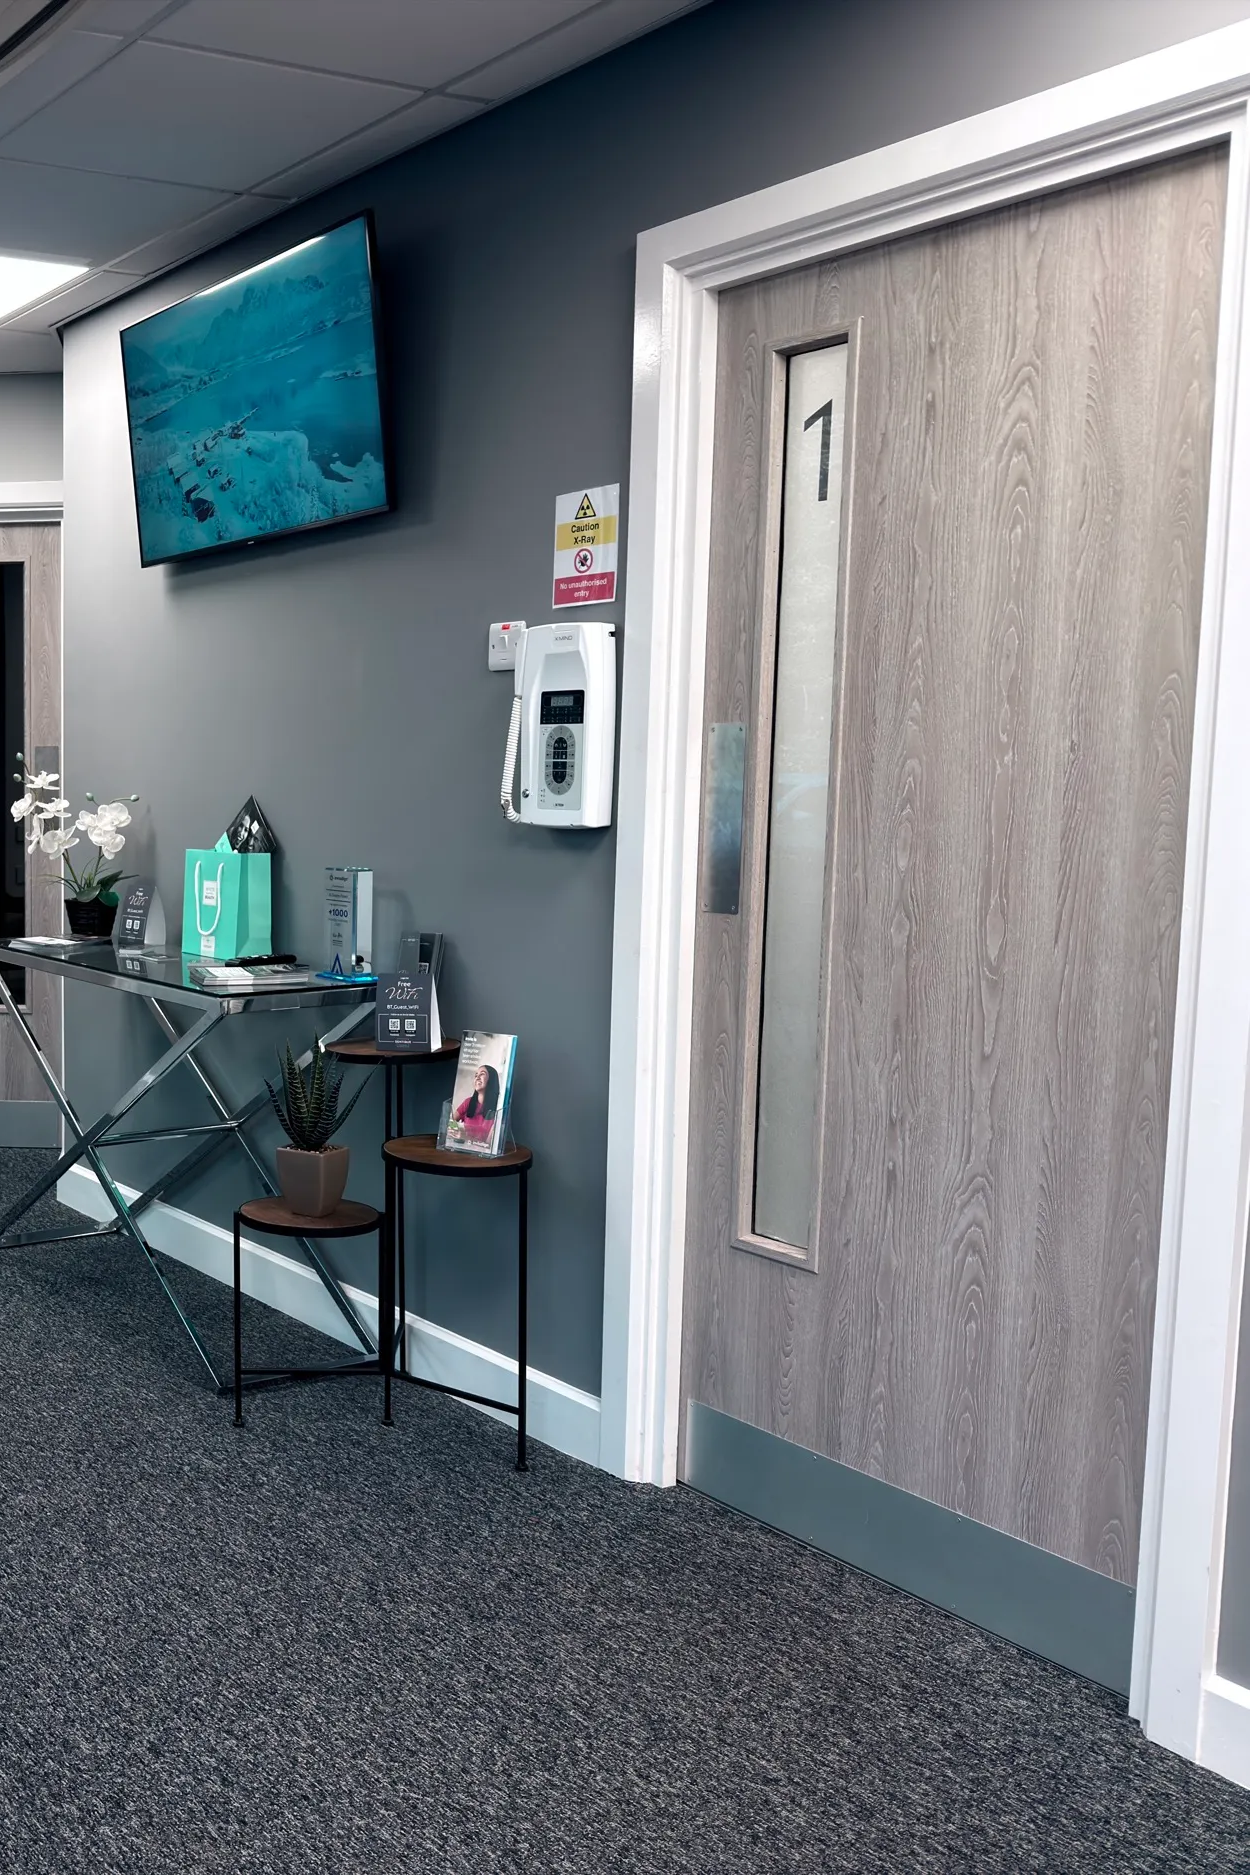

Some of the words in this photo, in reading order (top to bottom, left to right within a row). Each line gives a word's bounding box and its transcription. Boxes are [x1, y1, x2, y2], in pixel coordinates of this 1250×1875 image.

[803, 398, 833, 502] 1
[571, 522, 600, 534] Caution
[573, 535, 596, 545] X-Ray
[568, 578, 608, 589] unauthorised
[574, 590, 590, 598] entry
[328, 909, 348, 918] +1000
[385, 986, 424, 1000] WiFi
